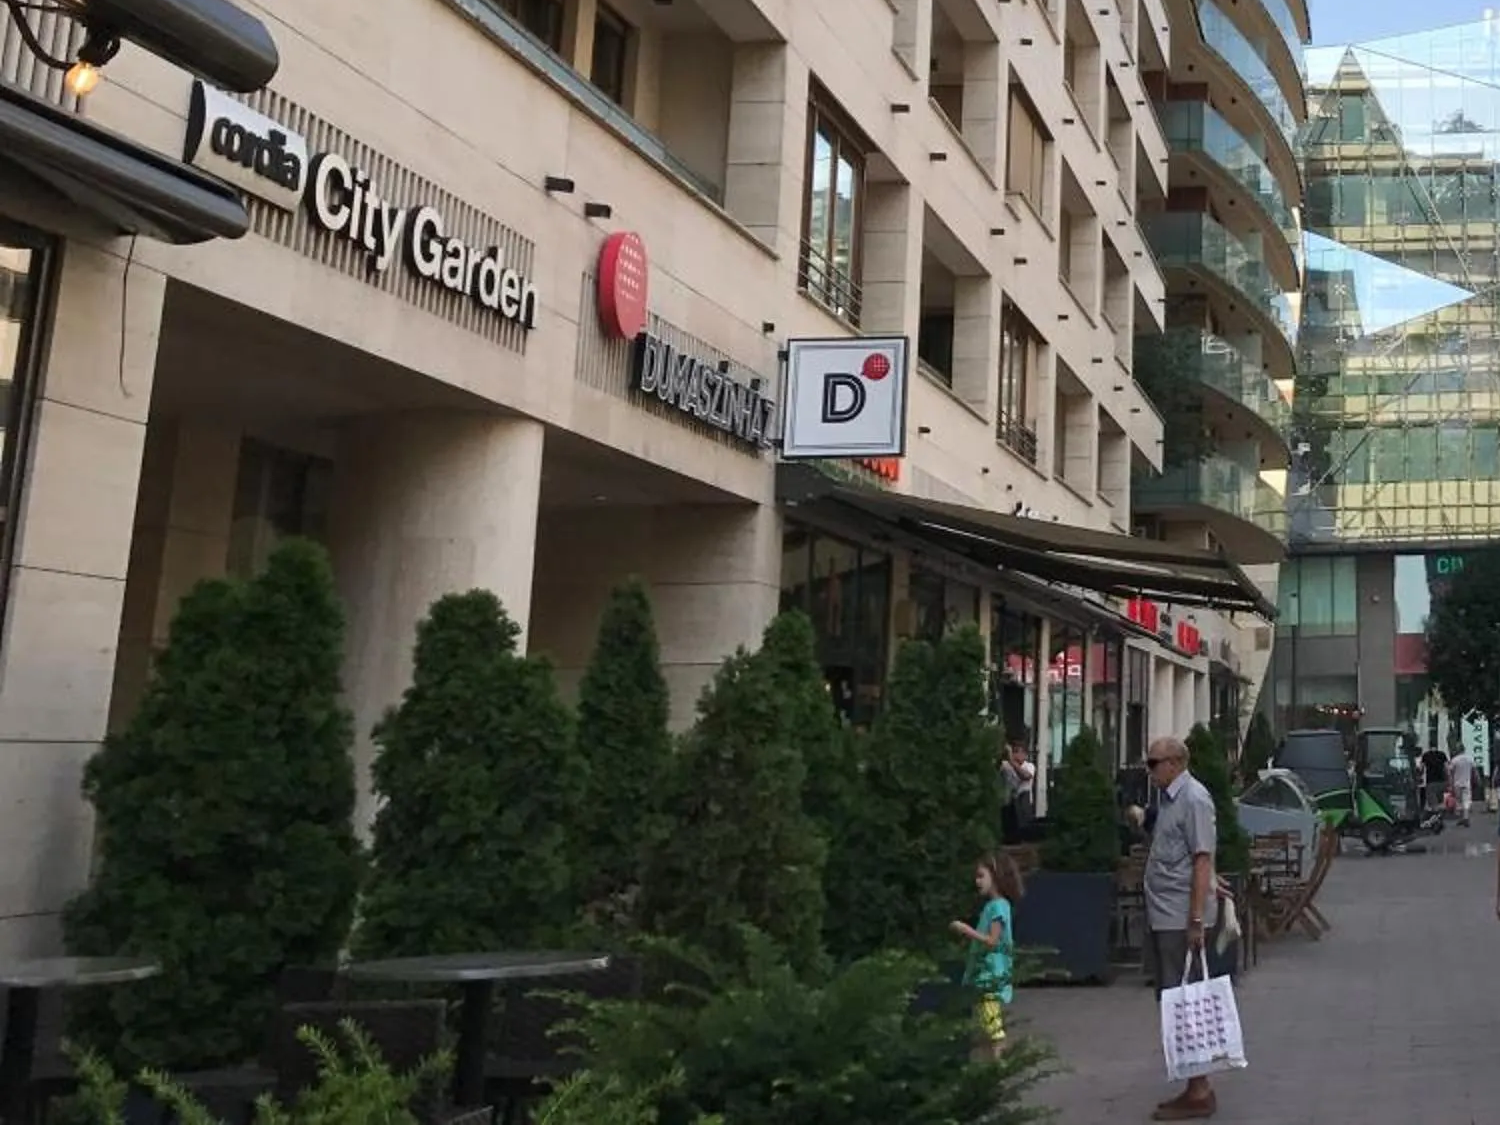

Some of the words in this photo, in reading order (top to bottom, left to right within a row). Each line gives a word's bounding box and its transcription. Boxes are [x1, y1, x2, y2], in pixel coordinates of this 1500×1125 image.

[210, 115, 300, 192] cordia
[309, 152, 407, 271] City
[408, 205, 540, 330] Garden
[821, 372, 867, 423] D
